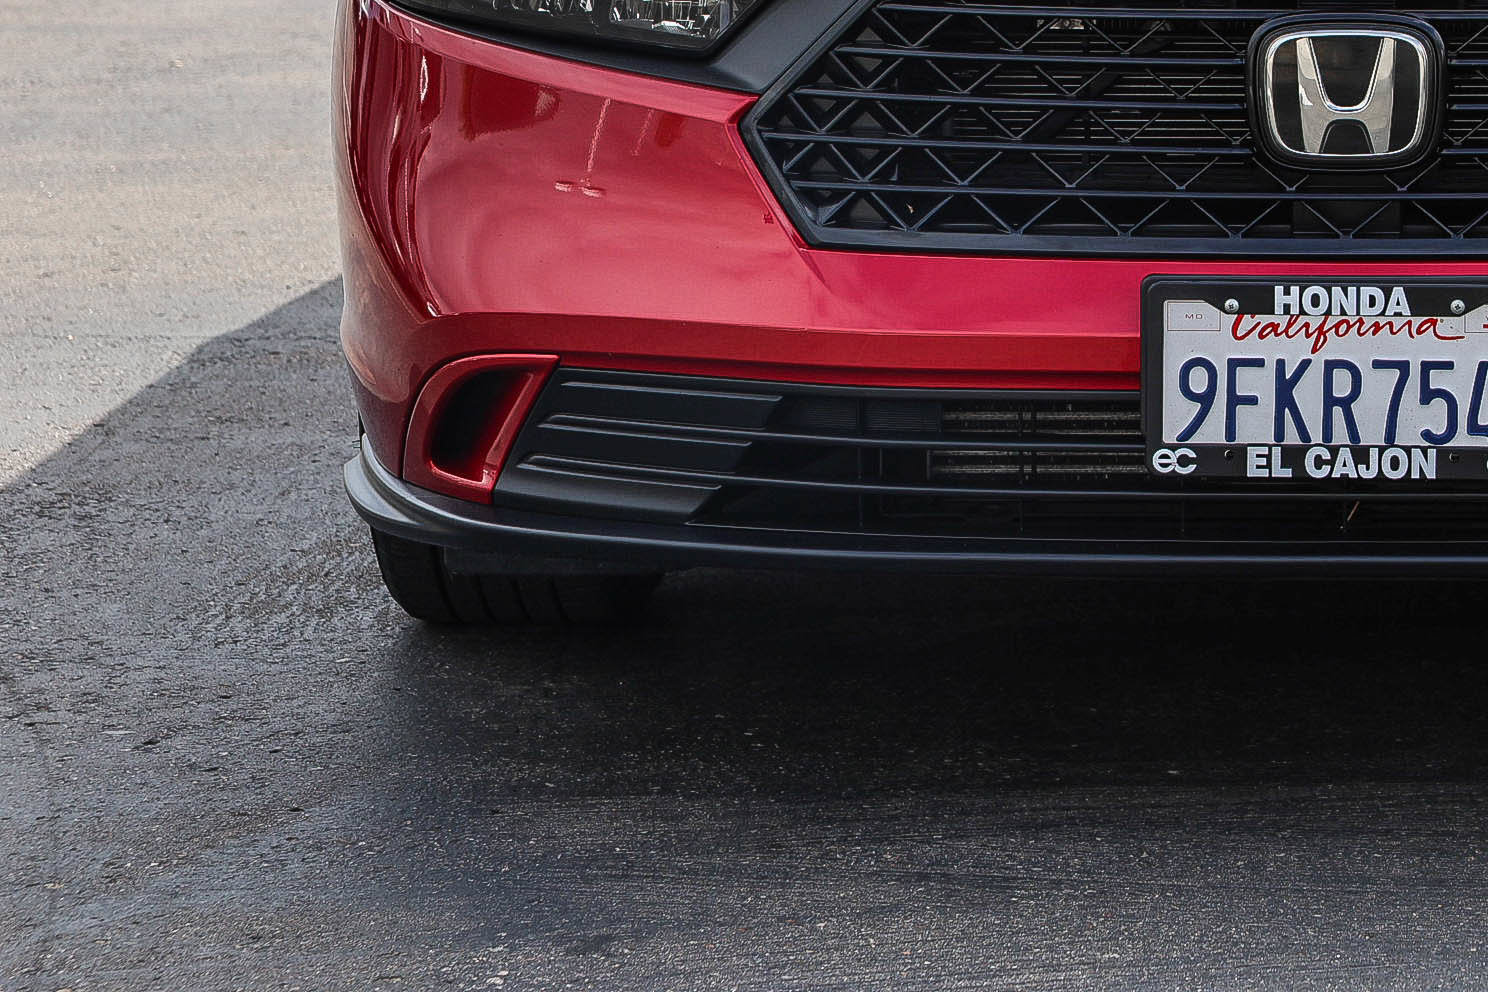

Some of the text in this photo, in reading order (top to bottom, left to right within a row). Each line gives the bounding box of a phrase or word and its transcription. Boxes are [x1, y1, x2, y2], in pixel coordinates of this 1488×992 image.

[1273, 285, 1411, 317] HONDA
[1231, 314, 1466, 354] California
[1246, 447, 1437, 479] EL CAJON
